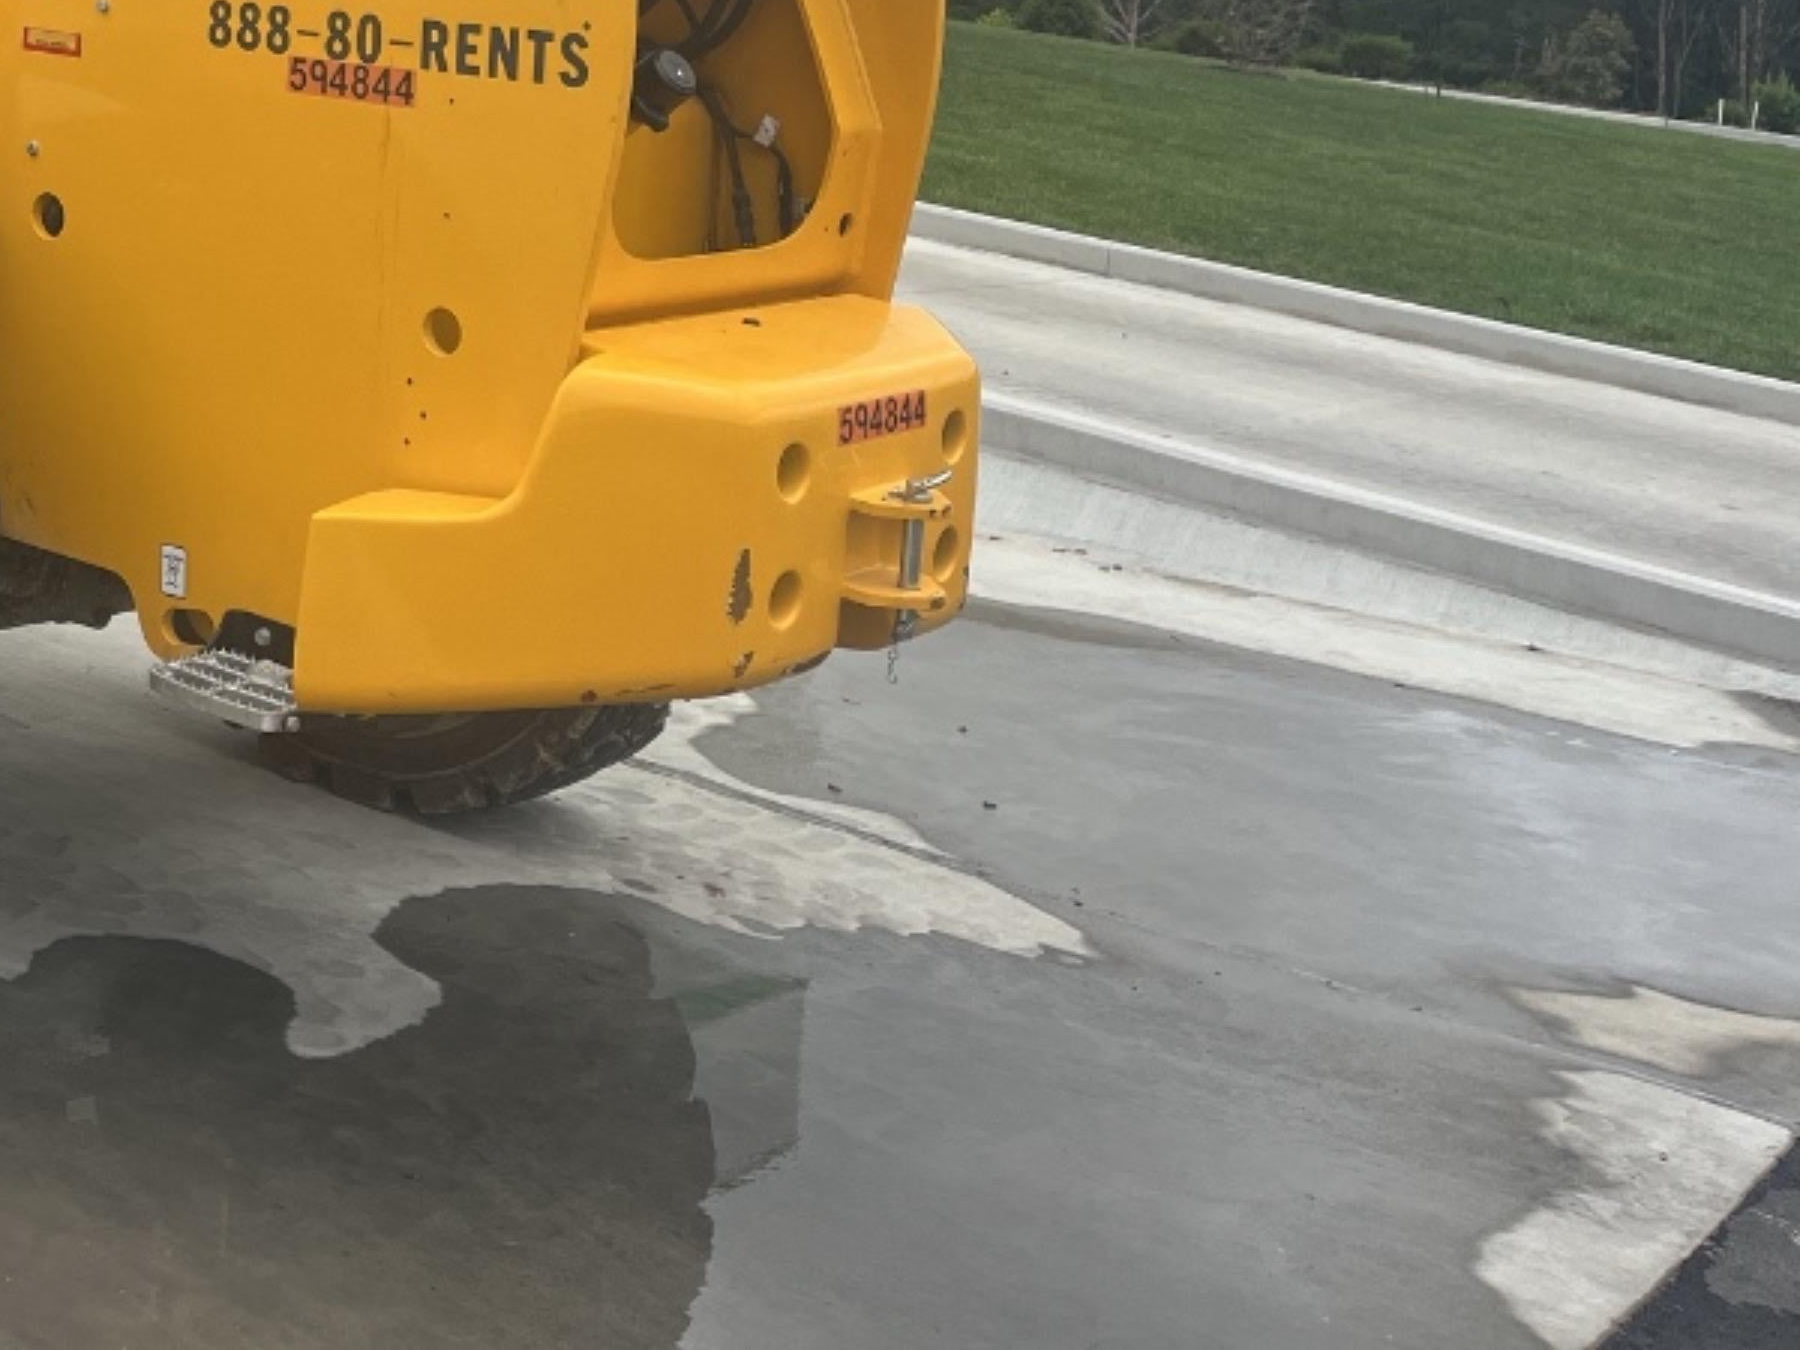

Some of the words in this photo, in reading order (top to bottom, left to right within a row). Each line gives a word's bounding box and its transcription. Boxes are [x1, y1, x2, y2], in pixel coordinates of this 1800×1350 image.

[208, 0, 590, 88] 888-80-RENTS
[290, 57, 416, 105] 594844
[838, 390, 926, 444] 594844
